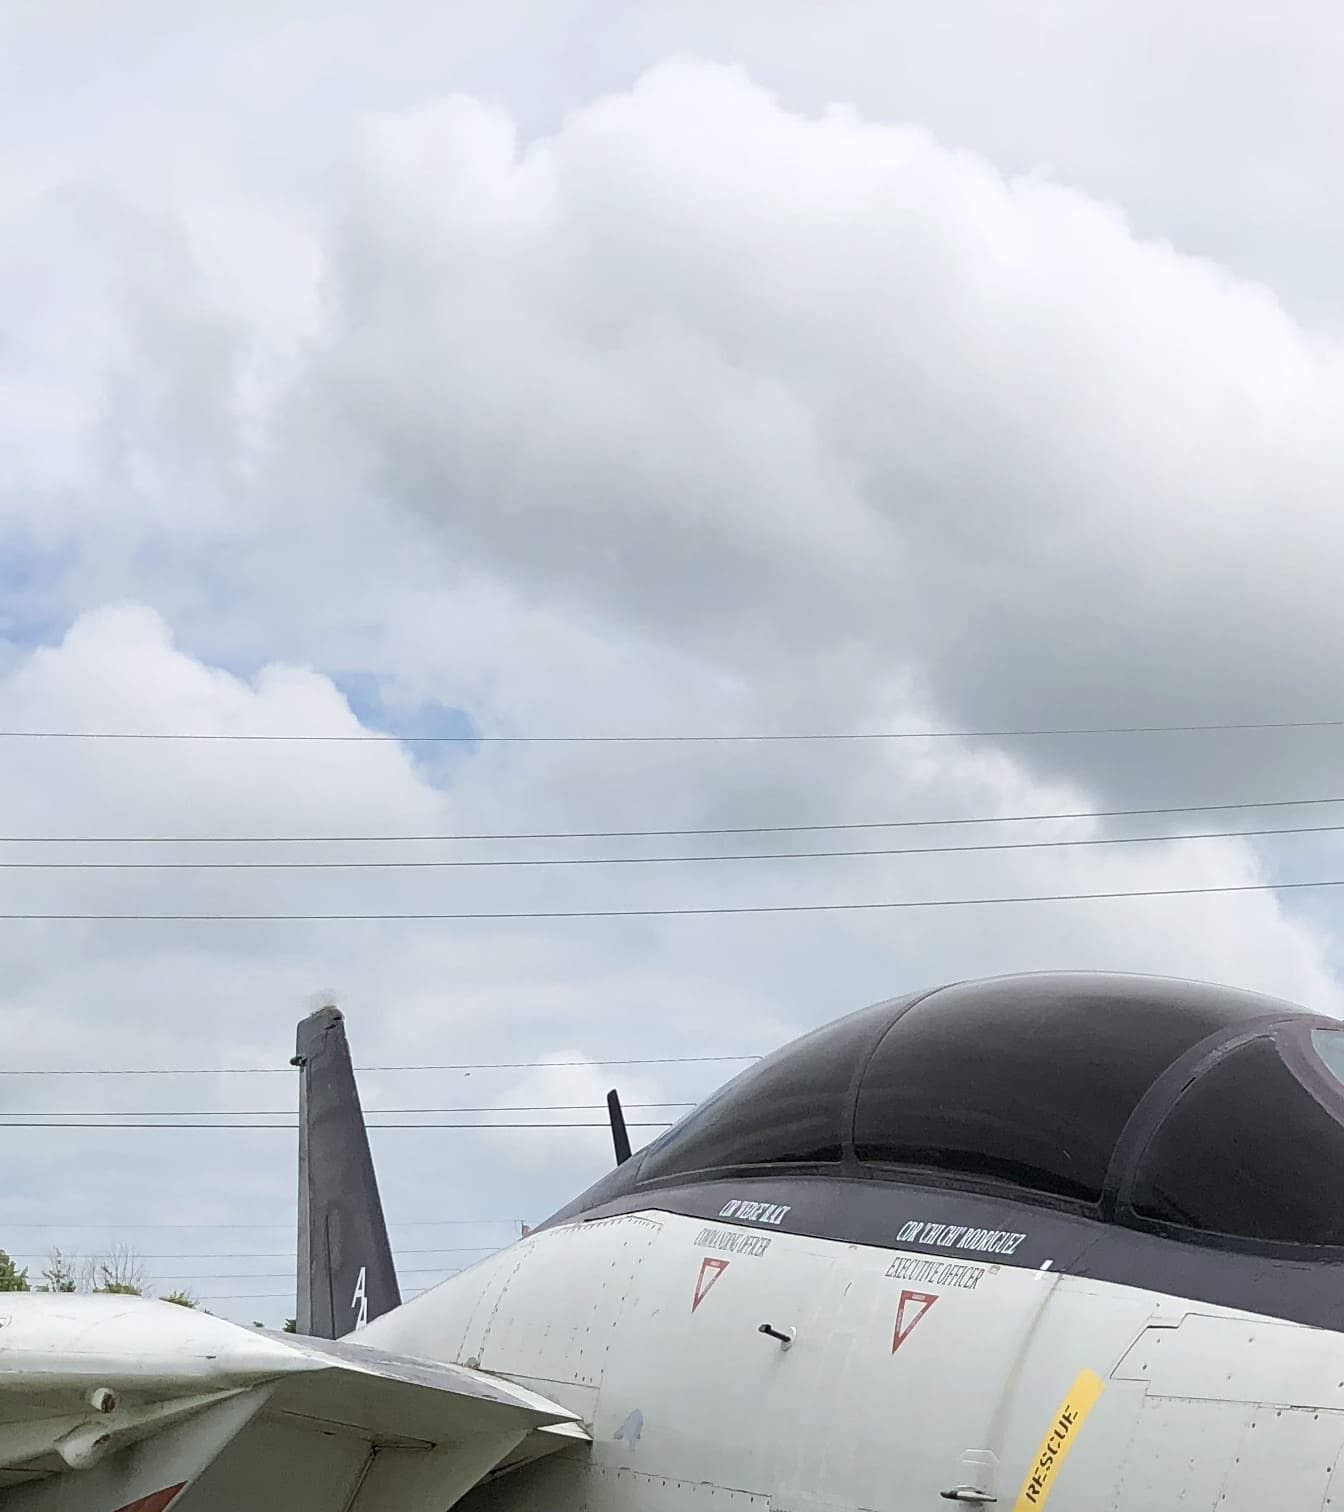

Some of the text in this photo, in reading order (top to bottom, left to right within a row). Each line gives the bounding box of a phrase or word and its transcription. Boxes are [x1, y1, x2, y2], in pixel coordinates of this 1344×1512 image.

[896, 1220, 925, 1242] CDR
[956, 1227, 1027, 1255] RODRIGUEZ
[885, 1256, 986, 1290] EXECUTIVE OFFICER
[1025, 1404, 1078, 1504] RESCUE
